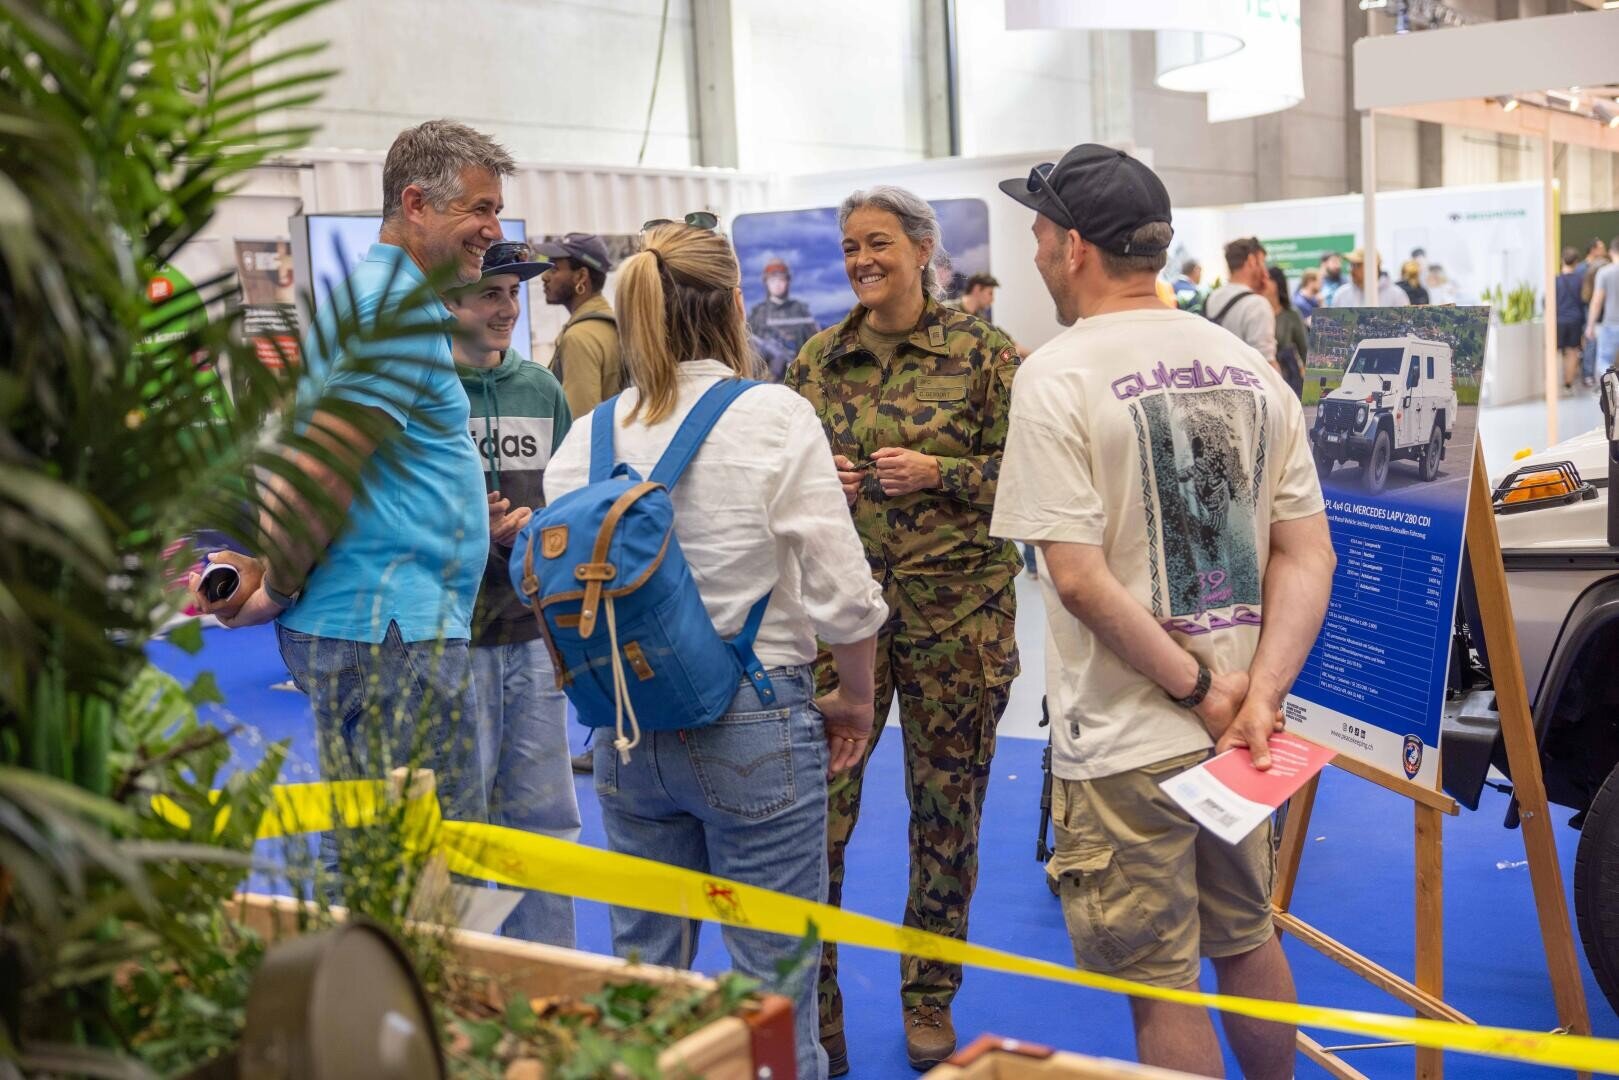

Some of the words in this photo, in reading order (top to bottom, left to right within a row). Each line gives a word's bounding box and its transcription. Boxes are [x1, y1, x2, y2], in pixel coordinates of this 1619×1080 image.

[471, 429, 537, 458] idas
[1344, 503, 1352, 512] GL
[1352, 504, 1387, 519] MERCEDES
[1387, 511, 1404, 522] LAPV
[1404, 514, 1417, 525] 280
[1418, 516, 1431, 527] CDI
